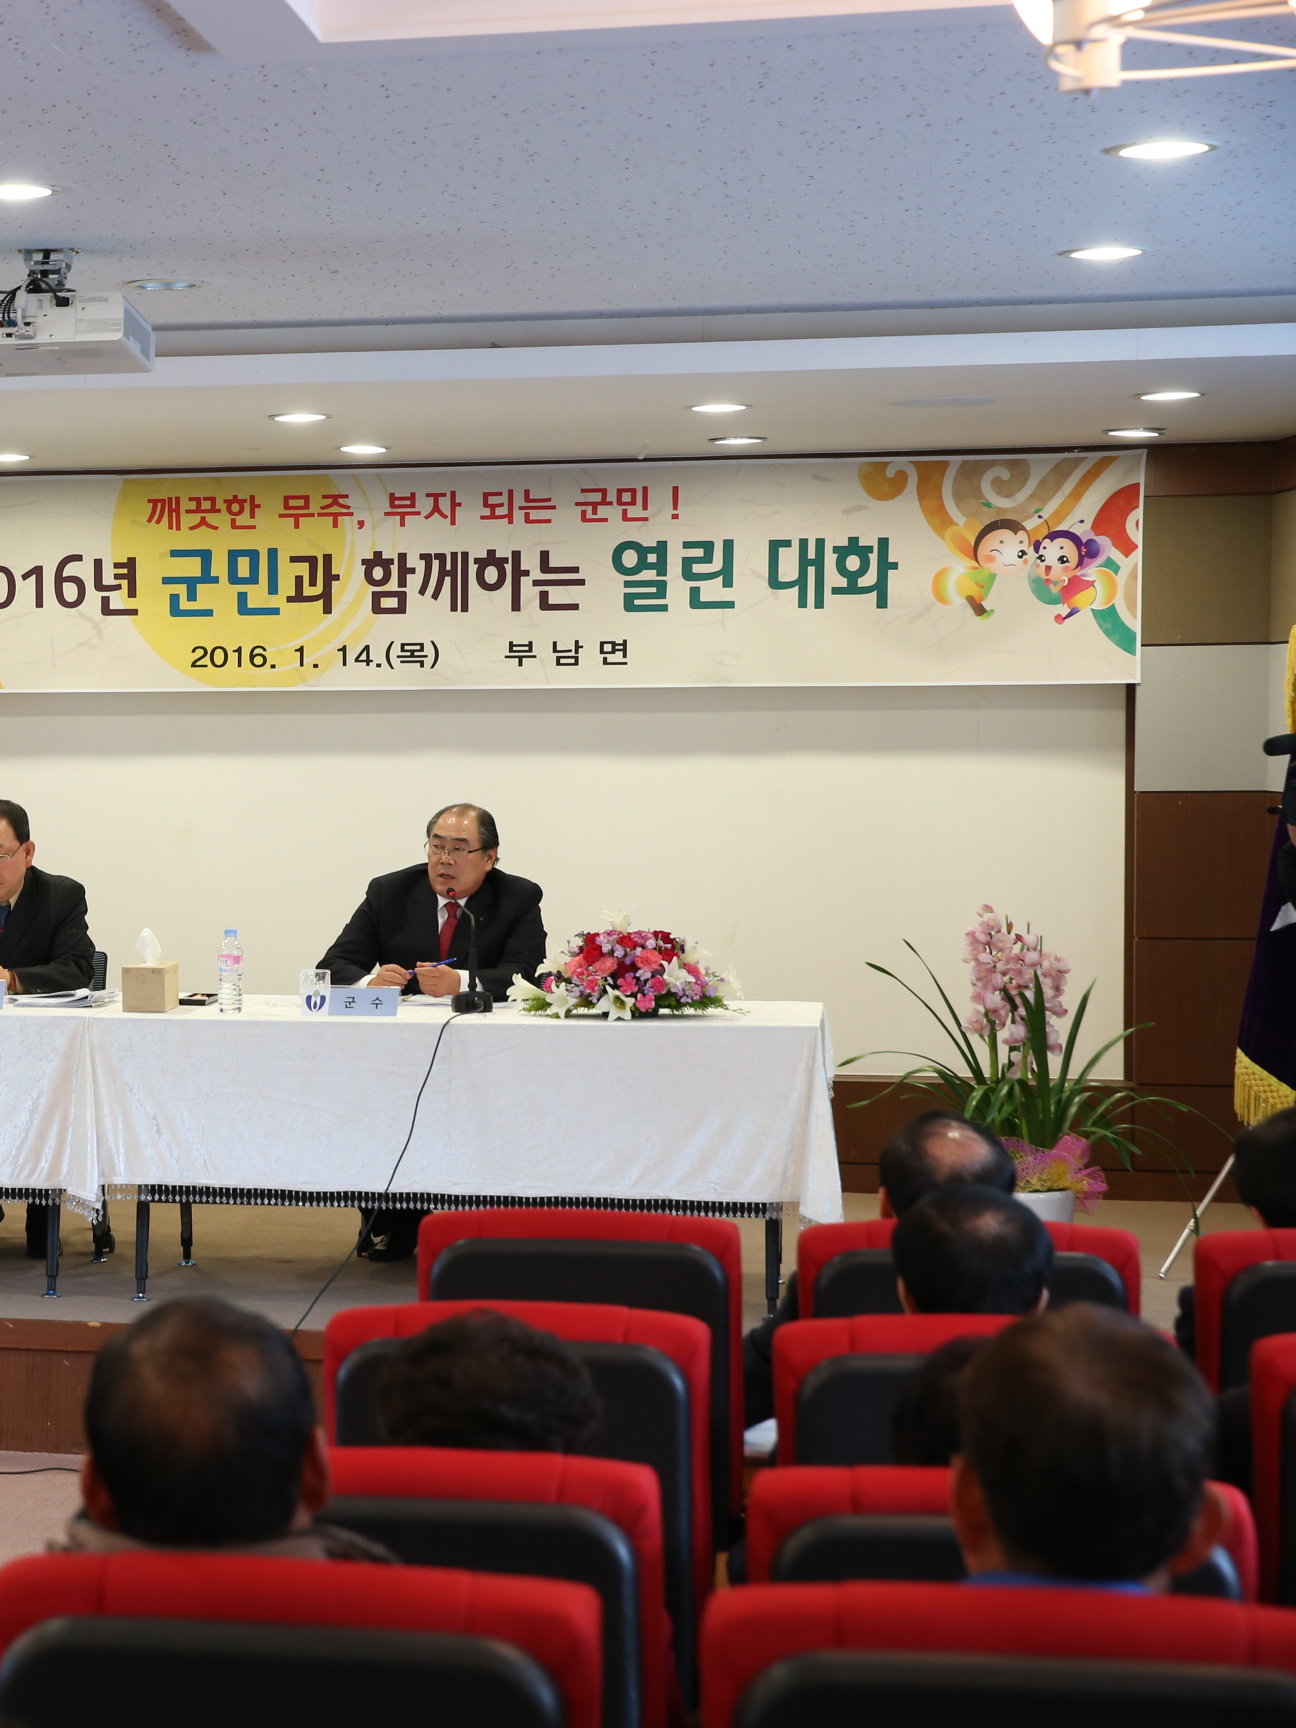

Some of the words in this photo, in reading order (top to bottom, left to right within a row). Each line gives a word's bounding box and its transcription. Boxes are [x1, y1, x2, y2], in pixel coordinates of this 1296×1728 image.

[147, 495, 261, 531] 깨끗한
[279, 494, 365, 529] 무주,
[385, 492, 461, 527] 부자
[481, 491, 555, 524] 되는
[161, 547, 341, 618] 군민과
[360, 548, 586, 615] 함께하는
[611, 538, 736, 613] 열린
[767, 536, 899, 610] 대화
[190, 645, 277, 669] 2016.
[336, 641, 441, 670] 14.(목)
